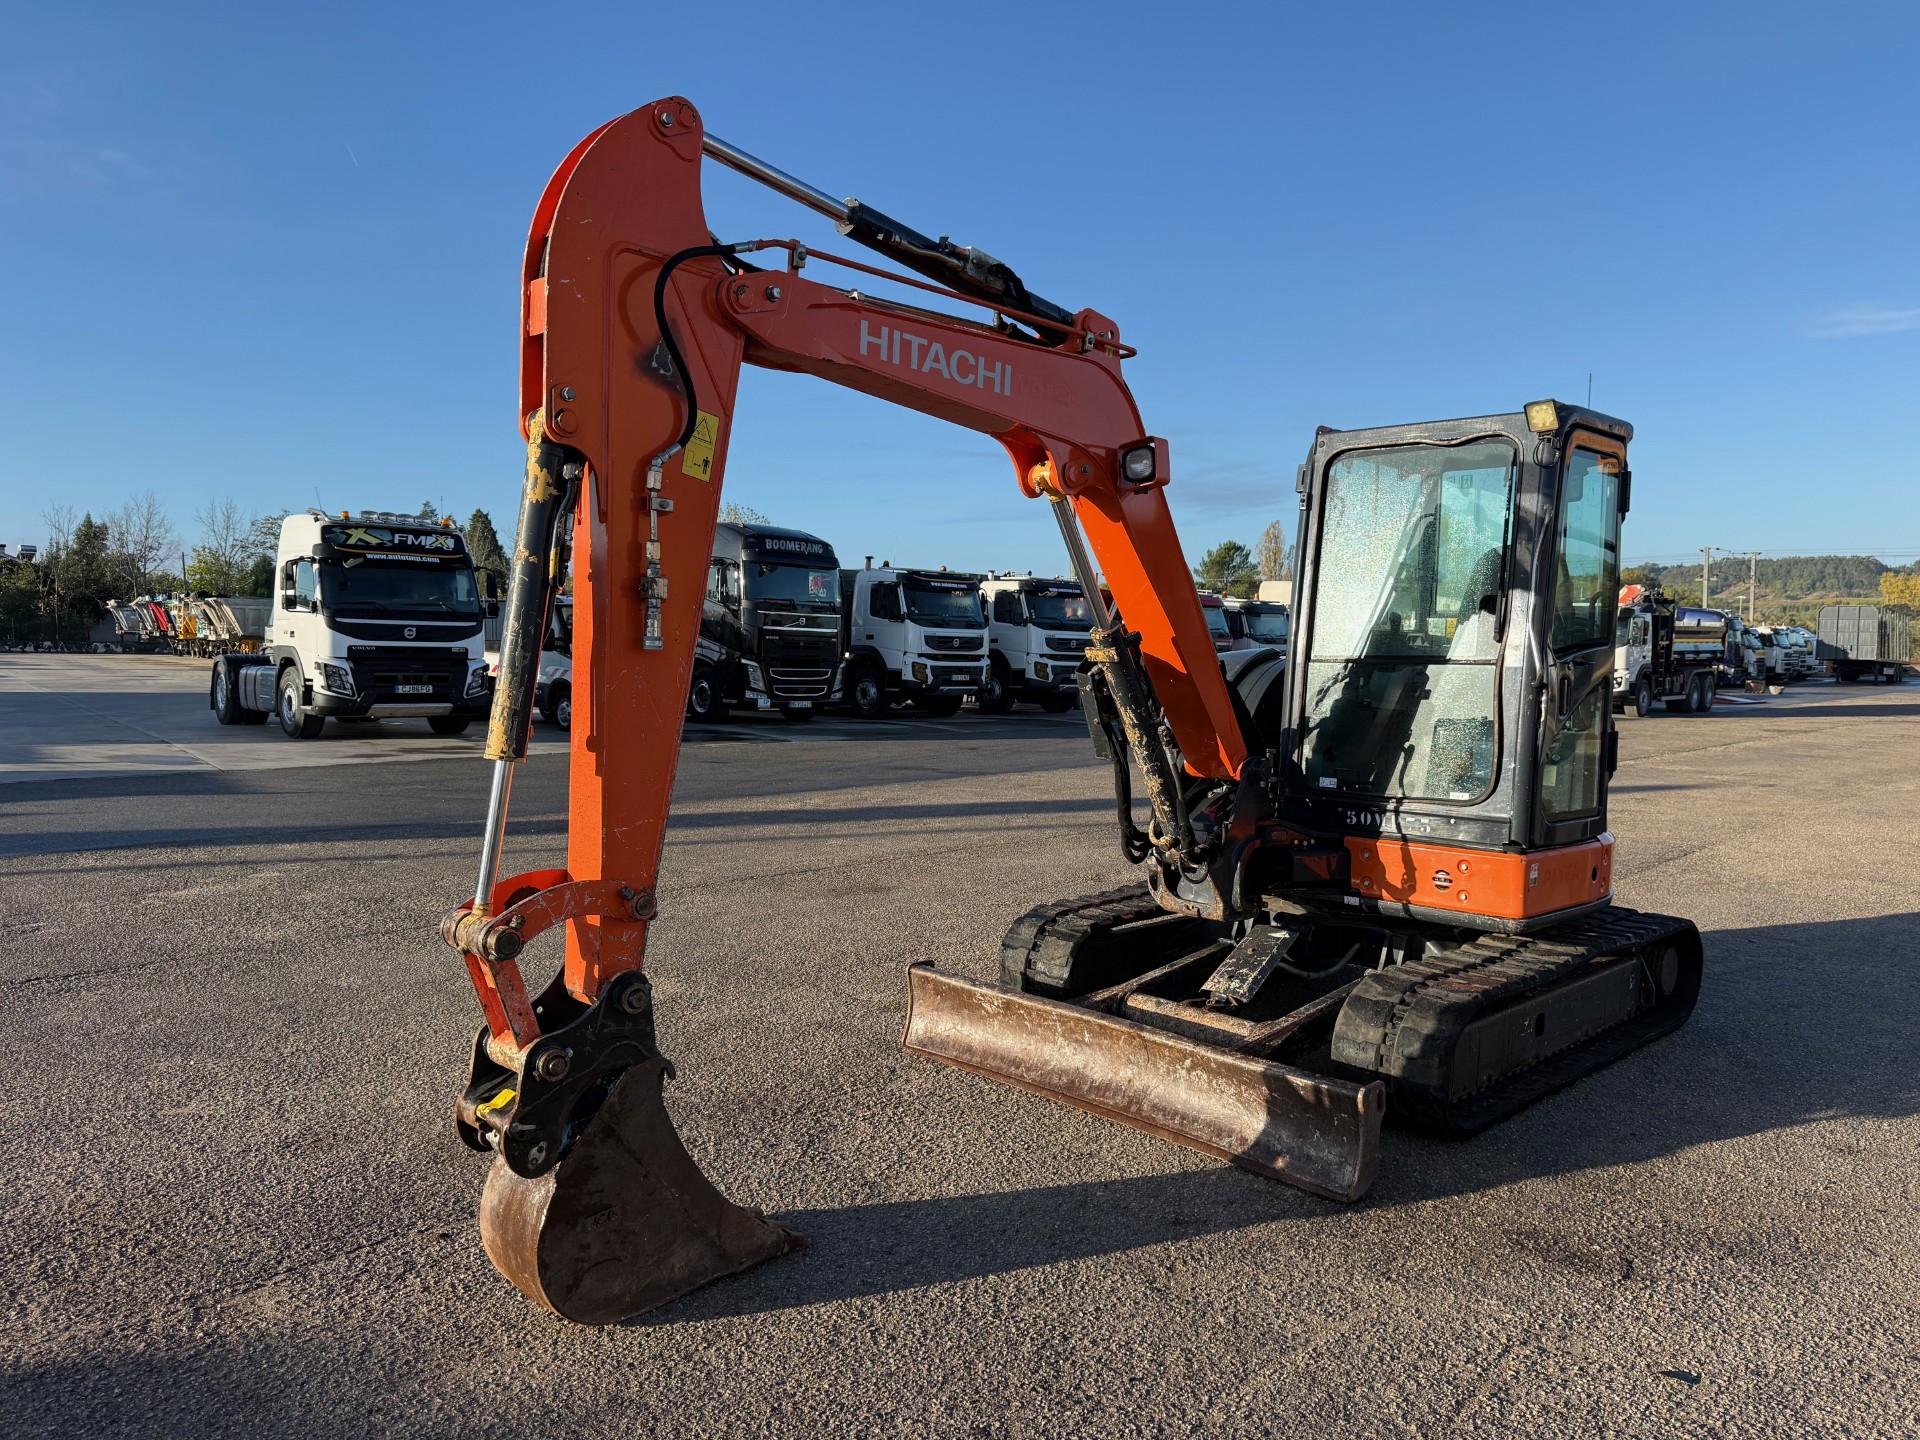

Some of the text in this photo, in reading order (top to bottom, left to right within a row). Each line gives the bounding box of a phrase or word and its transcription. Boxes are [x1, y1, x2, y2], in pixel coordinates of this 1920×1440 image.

[859, 319, 1012, 397] HITACHI
[394, 533, 455, 551] FMX
[765, 538, 824, 555] BOOMERANG
[401, 685, 431, 693] CJ86FG
